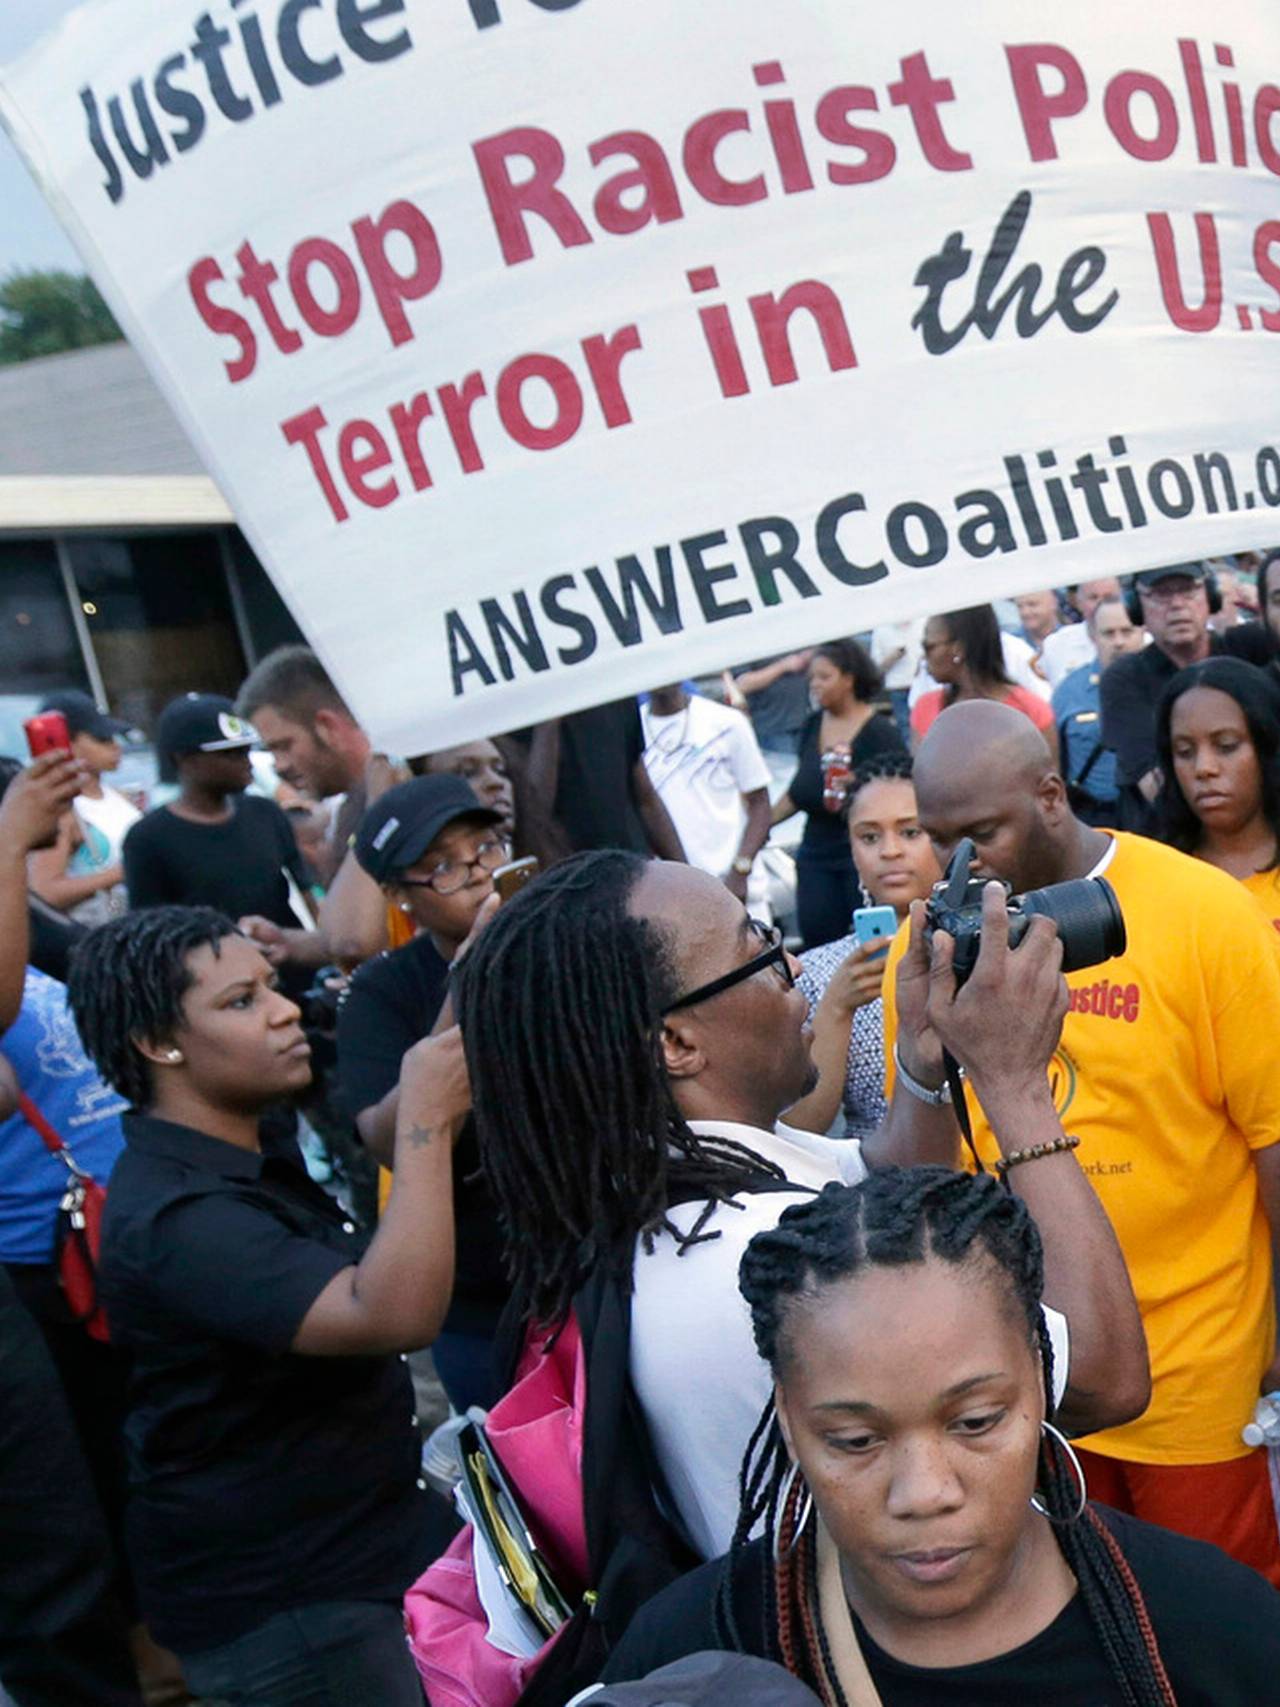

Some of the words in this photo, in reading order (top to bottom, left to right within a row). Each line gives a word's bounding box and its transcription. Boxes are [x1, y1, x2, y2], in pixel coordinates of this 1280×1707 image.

[79, 0, 413, 205] Justice
[187, 199, 443, 384] Stop
[472, 52, 972, 266] Racist
[281, 324, 642, 523] Terror
[687, 266, 858, 398] in
[911, 190, 1119, 356] the
